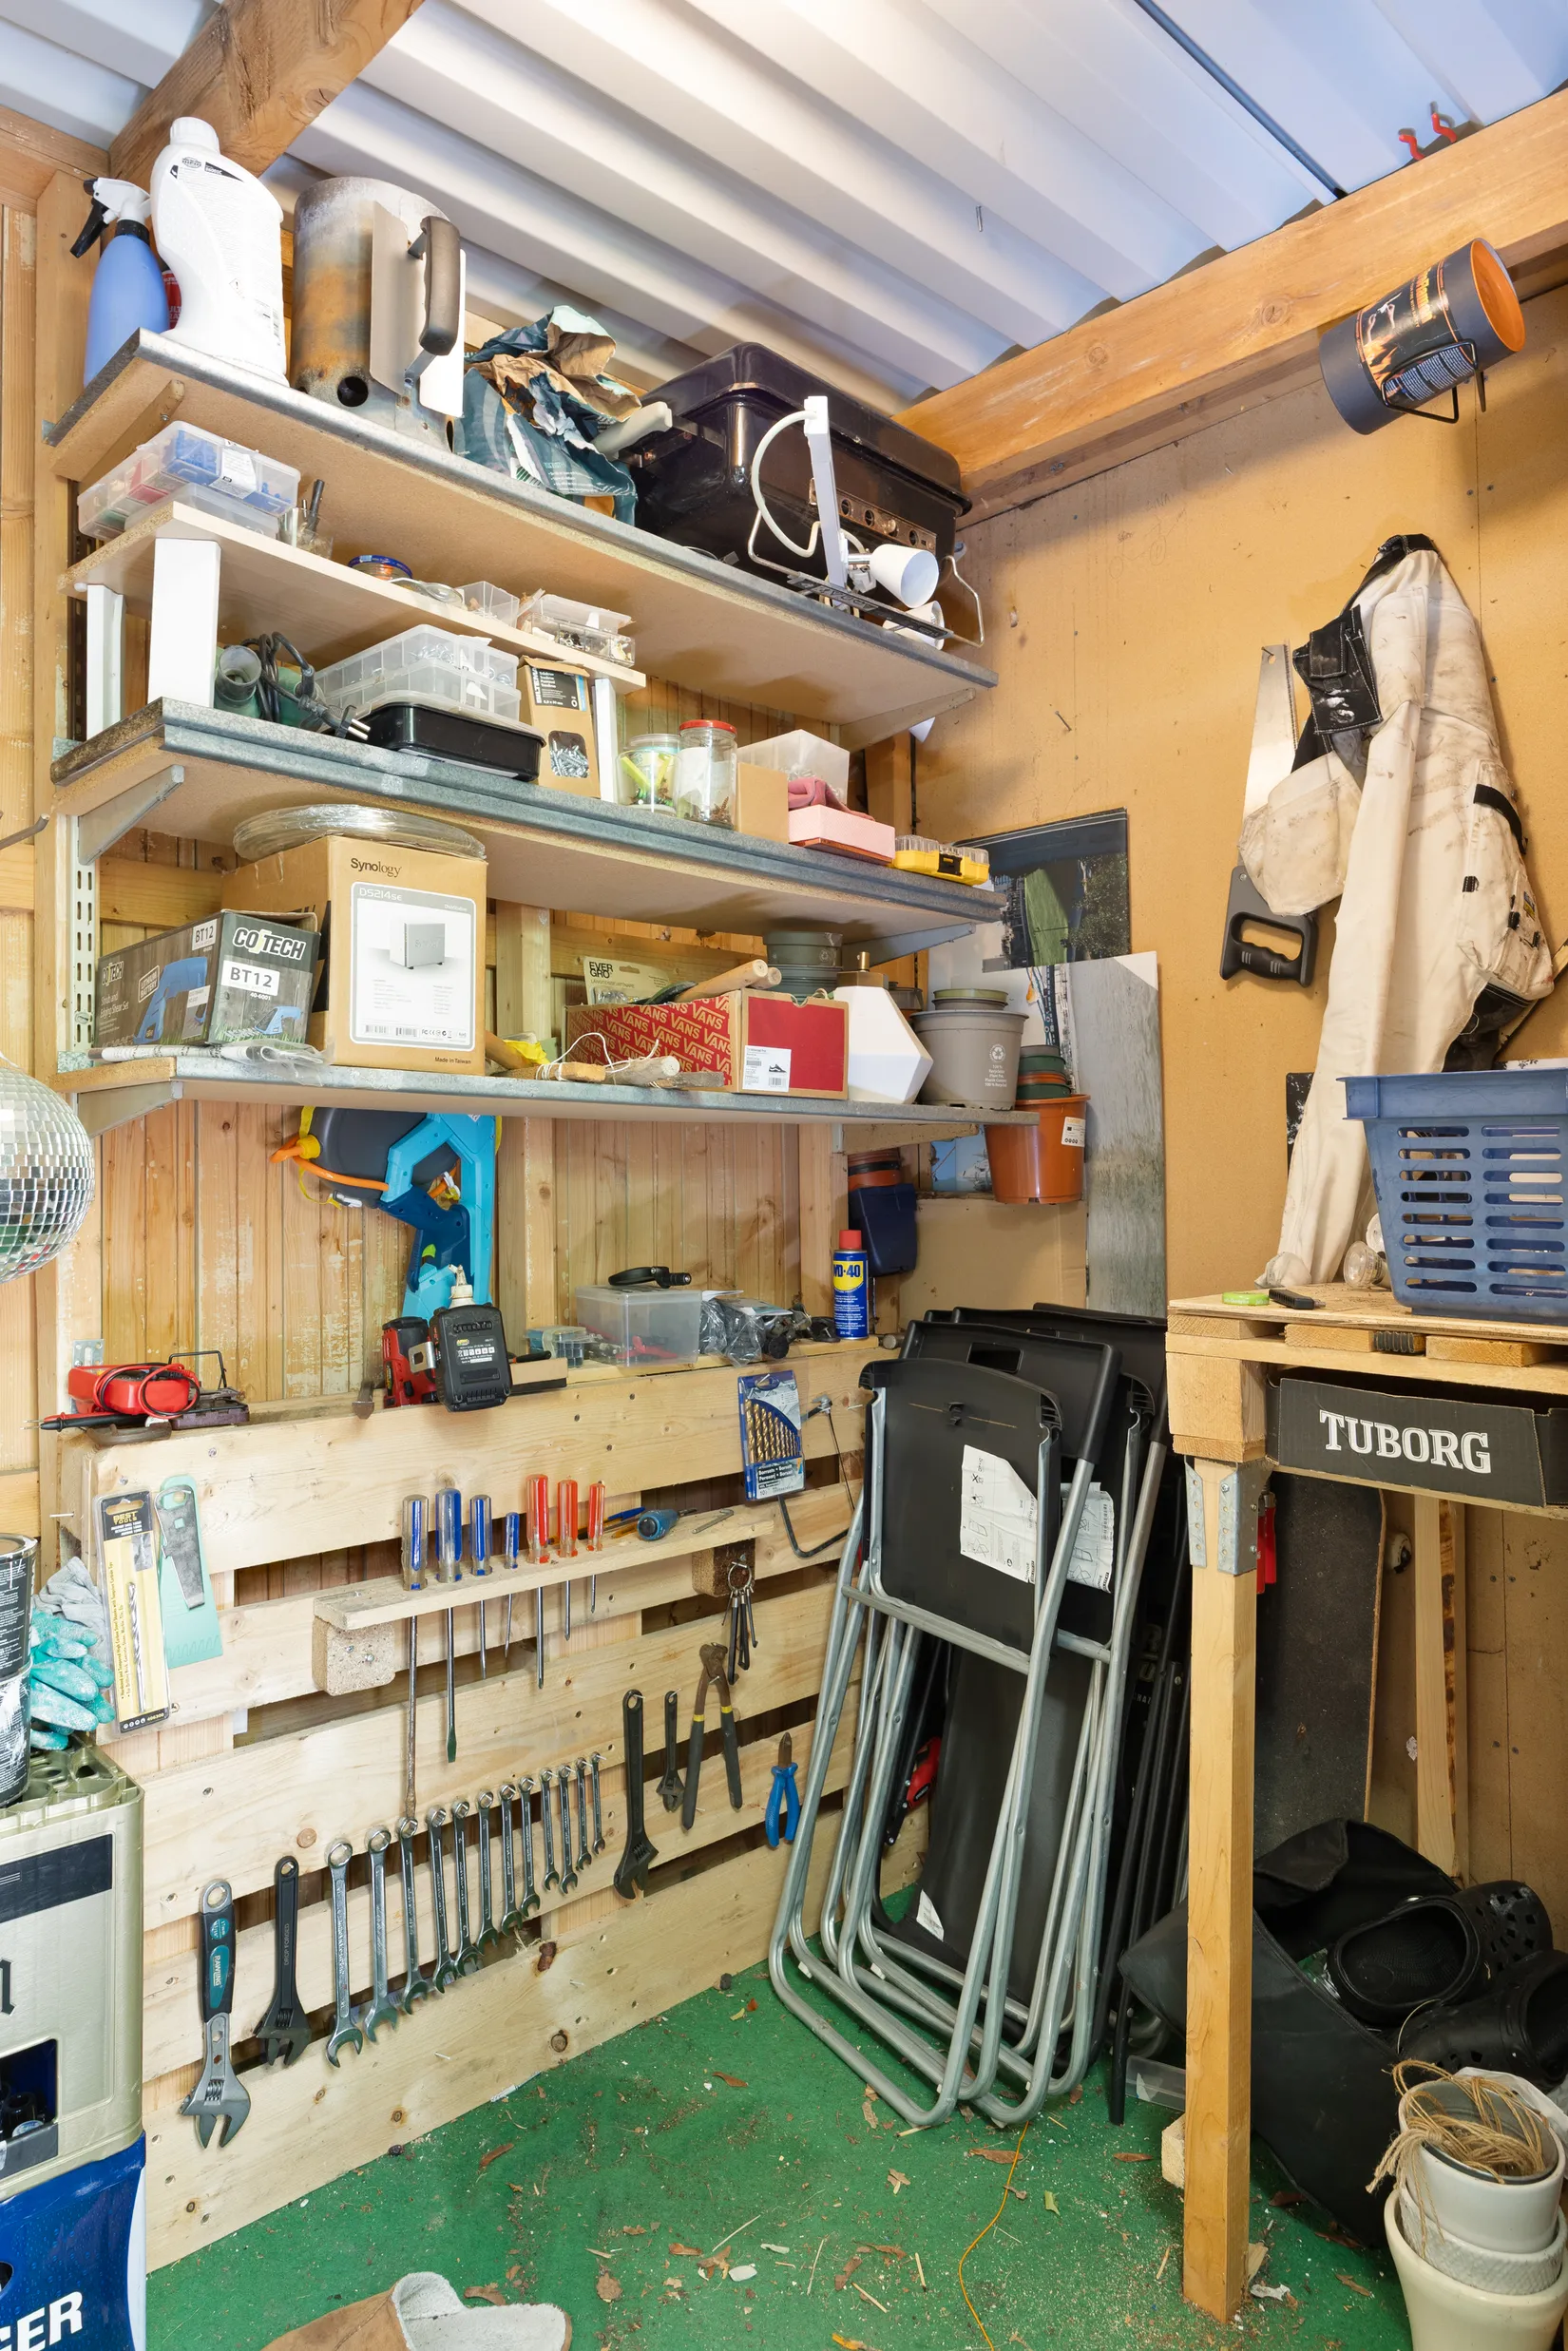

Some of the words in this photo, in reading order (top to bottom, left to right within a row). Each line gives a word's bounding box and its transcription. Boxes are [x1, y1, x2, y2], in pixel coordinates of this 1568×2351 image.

[351, 858, 401, 877] Synology
[195, 926, 214, 944] BT12
[230, 966, 273, 987] BT12
[589, 962, 613, 972] EVER
[590, 969, 610, 979] GRO
[621, 1007, 650, 1033] VANS
[671, 1012, 702, 1040] VANS
[692, 1003, 725, 1030] VANS
[606, 1016, 632, 1041] VANS
[652, 1023, 682, 1048] VANS
[684, 1038, 715, 1064] VANS
[1319, 1408, 1491, 1474] TUBORG
[113, 1511, 139, 1521] BEST
[114, 1516, 138, 1525] TOOLS
